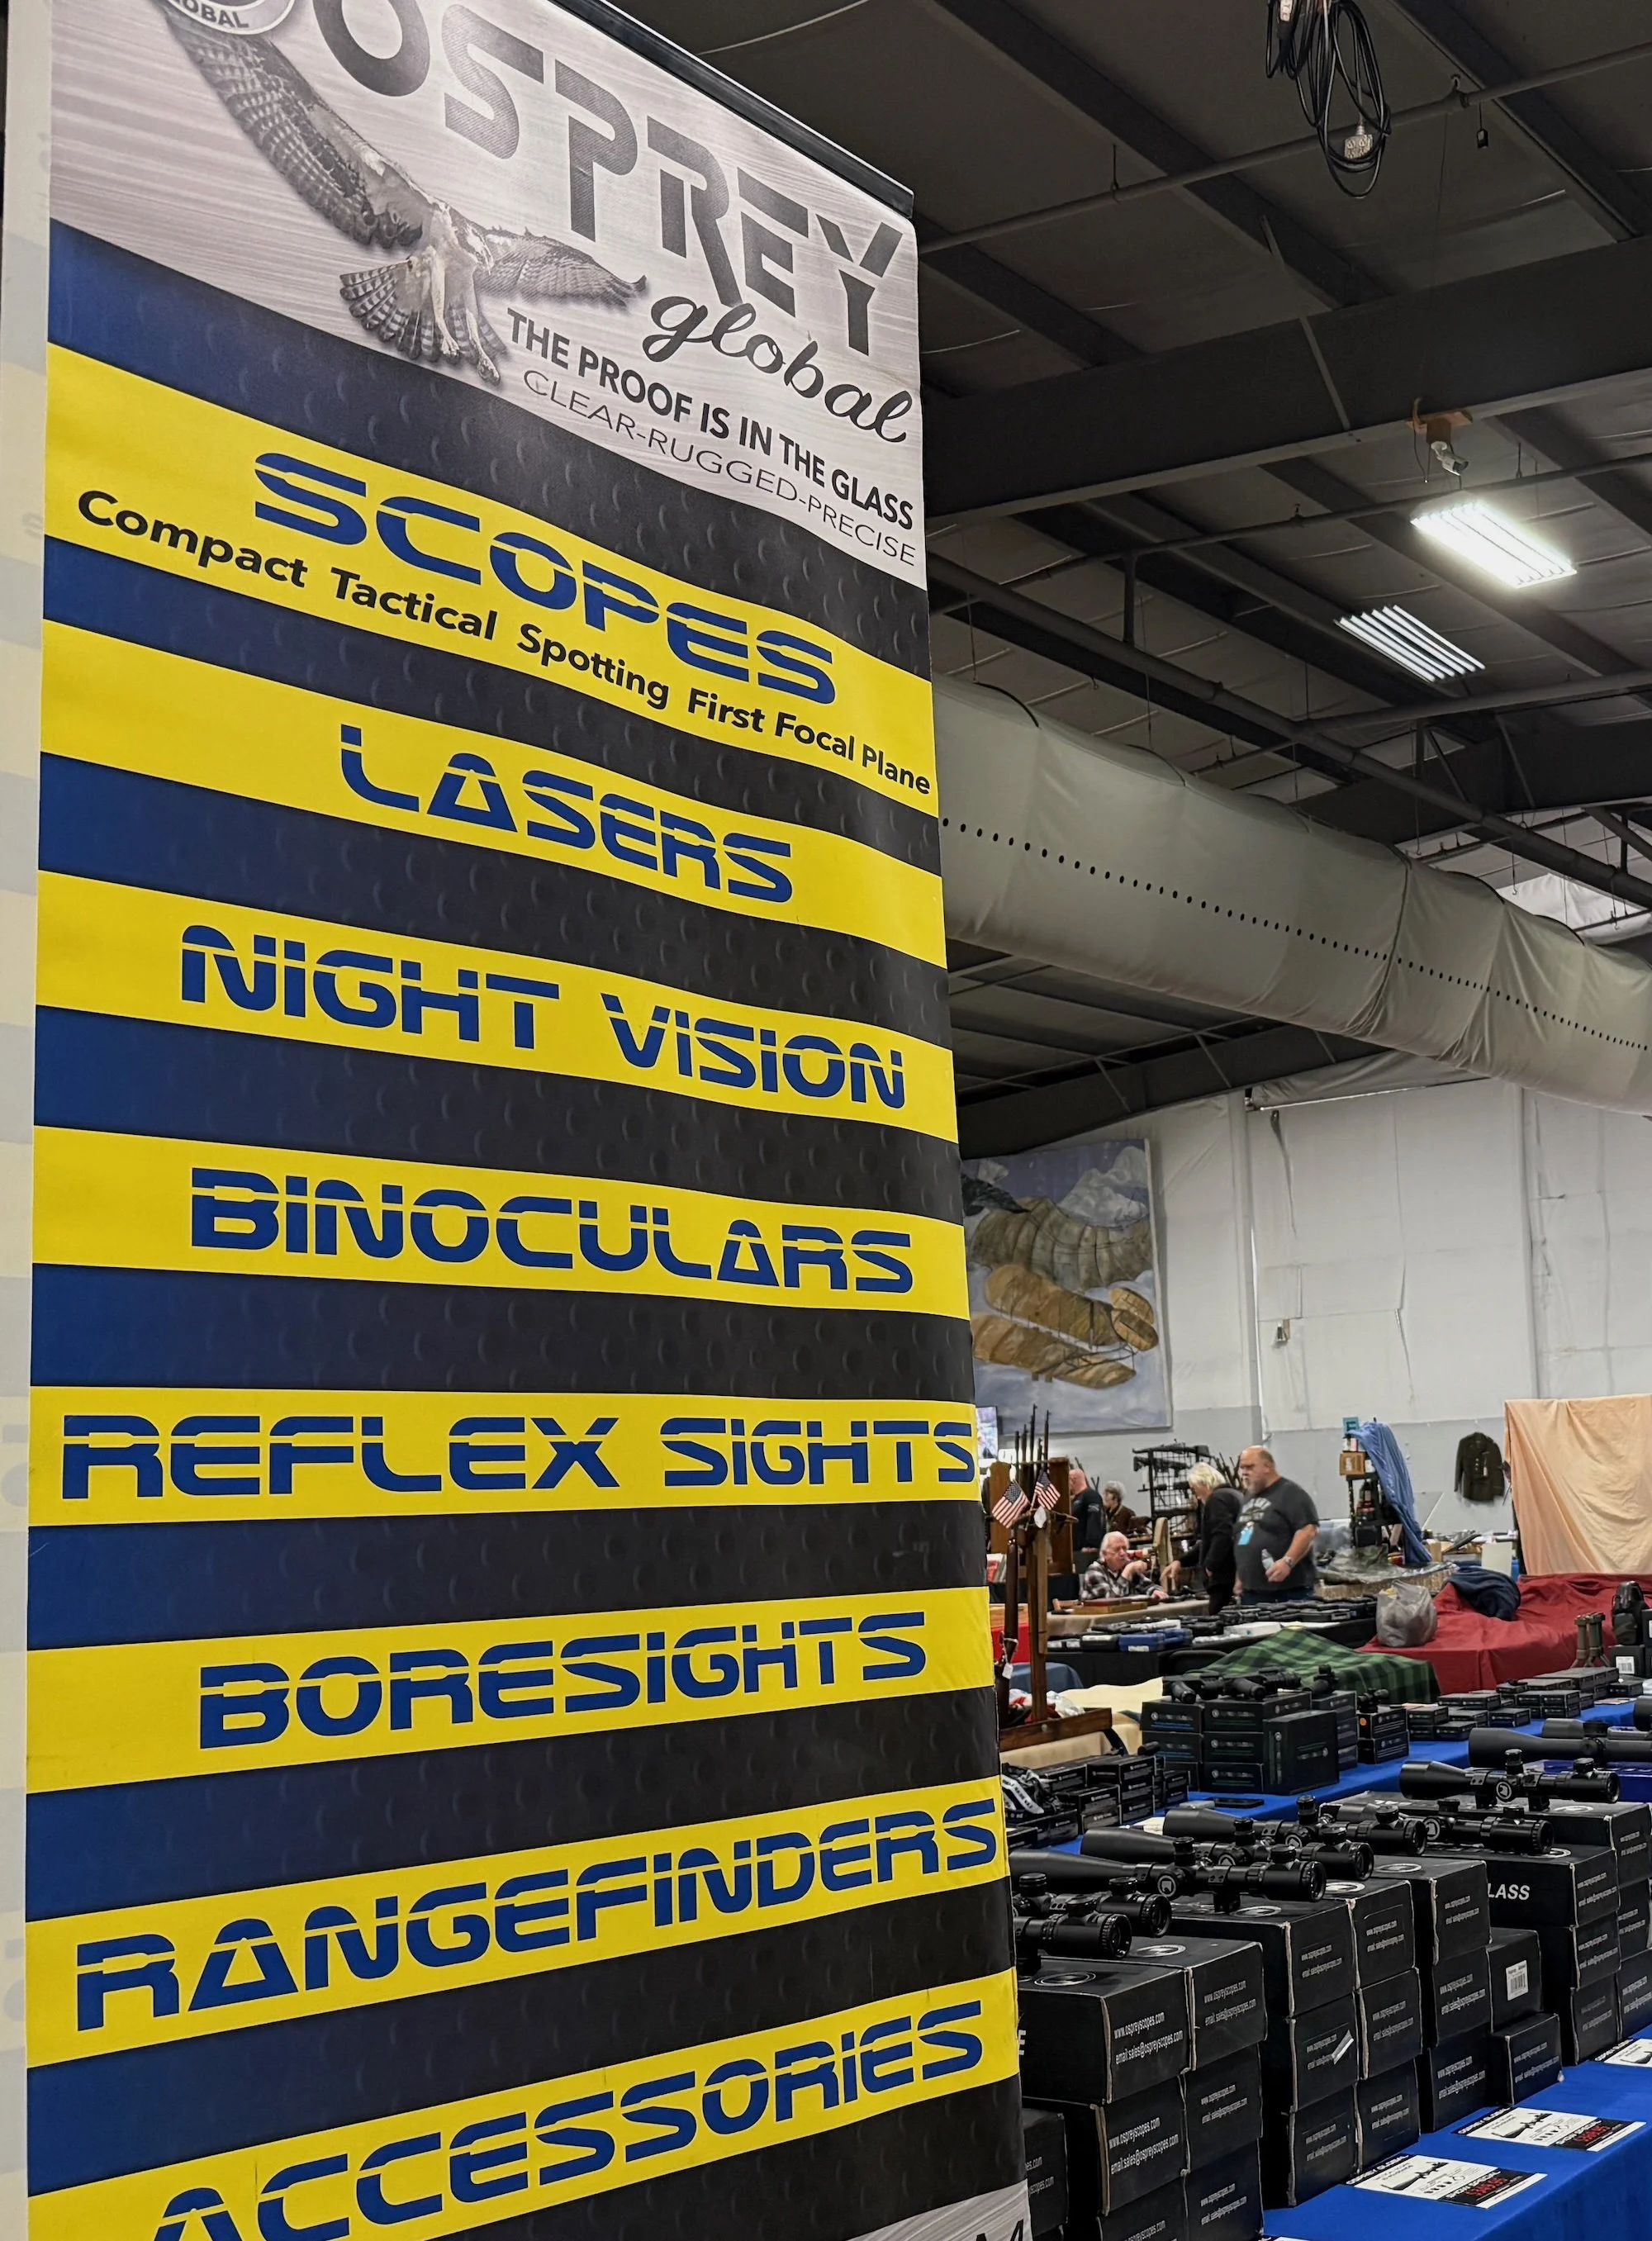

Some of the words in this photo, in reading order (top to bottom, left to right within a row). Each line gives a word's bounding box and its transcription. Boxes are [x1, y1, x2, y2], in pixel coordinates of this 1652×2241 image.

[311, 0, 903, 356] OSPREY
[507, 307, 570, 369] THE
[578, 345, 692, 422] PROOF
[700, 402, 730, 439] IS
[738, 415, 771, 457] IN
[779, 432, 826, 488] THE
[831, 468, 914, 531] GLASS
[642, 296, 913, 443] global
[523, 369, 917, 567] CLEAR-RUGGED-PRECISE
[78, 490, 309, 587] Compact
[330, 567, 498, 641] Tactical
[517, 624, 669, 710] Spotting
[687, 687, 766, 733] First
[775, 712, 855, 761] Focal
[862, 744, 931, 795] Plane
[254, 452, 836, 705] SCOPES
[340, 724, 794, 904] LASERS
[180, 924, 560, 1050] NIGHT
[601, 993, 904, 1109] VISION
[191, 1166, 914, 1294] BINOCULARS
[62, 1414, 620, 1501] REFLEX
[661, 1417, 976, 1487] SIGHTS
[199, 1611, 926, 1750] BORESIGHTS
[75, 1797, 998, 2032] RANGEFINDERS
[1488, 1883, 1530, 1901] LASS
[150, 1999, 984, 2241] ACCESSORIES
